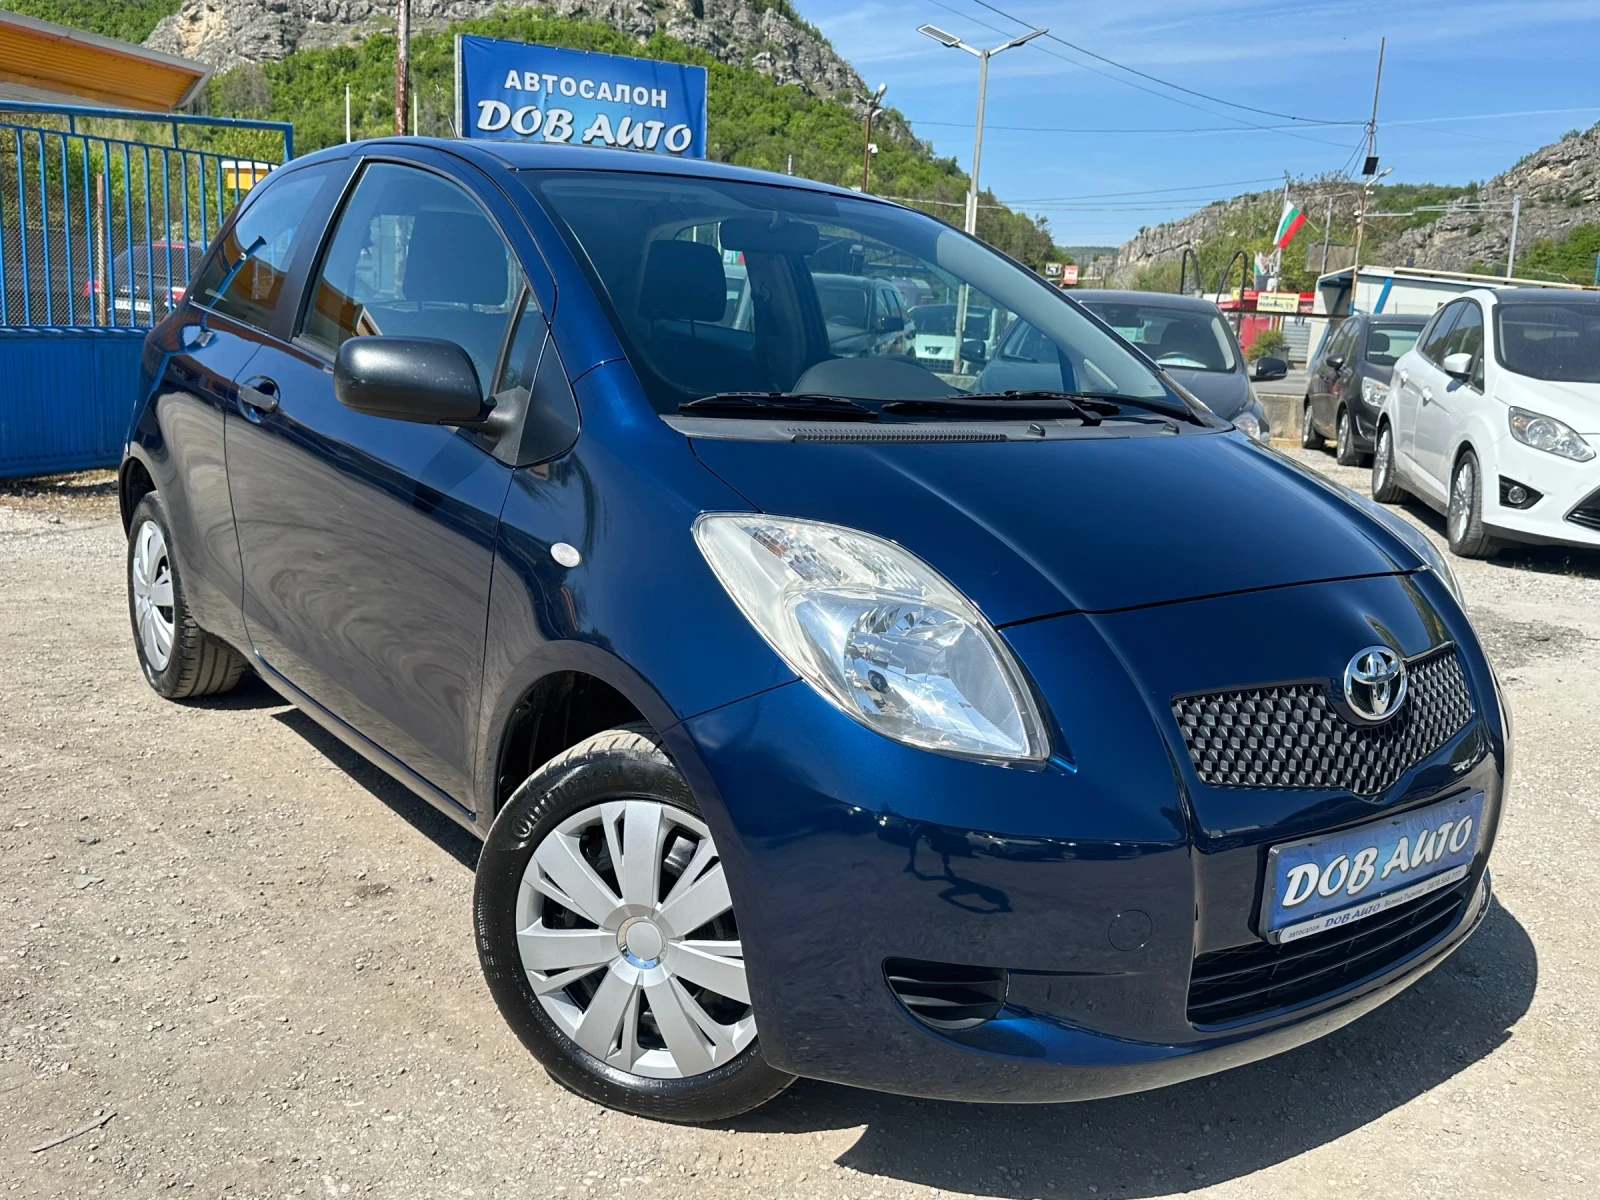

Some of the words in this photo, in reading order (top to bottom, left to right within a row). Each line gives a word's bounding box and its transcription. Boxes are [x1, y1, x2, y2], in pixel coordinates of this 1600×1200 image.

[504, 70, 667, 108] АВТОСАЛОН
[477, 99, 574, 143] DOB
[582, 113, 692, 152] AUTO
[1281, 847, 1379, 908] DOB
[1381, 814, 1473, 880] AUTO
[1324, 912, 1351, 928] DOB
[1352, 902, 1381, 920] AUTO
